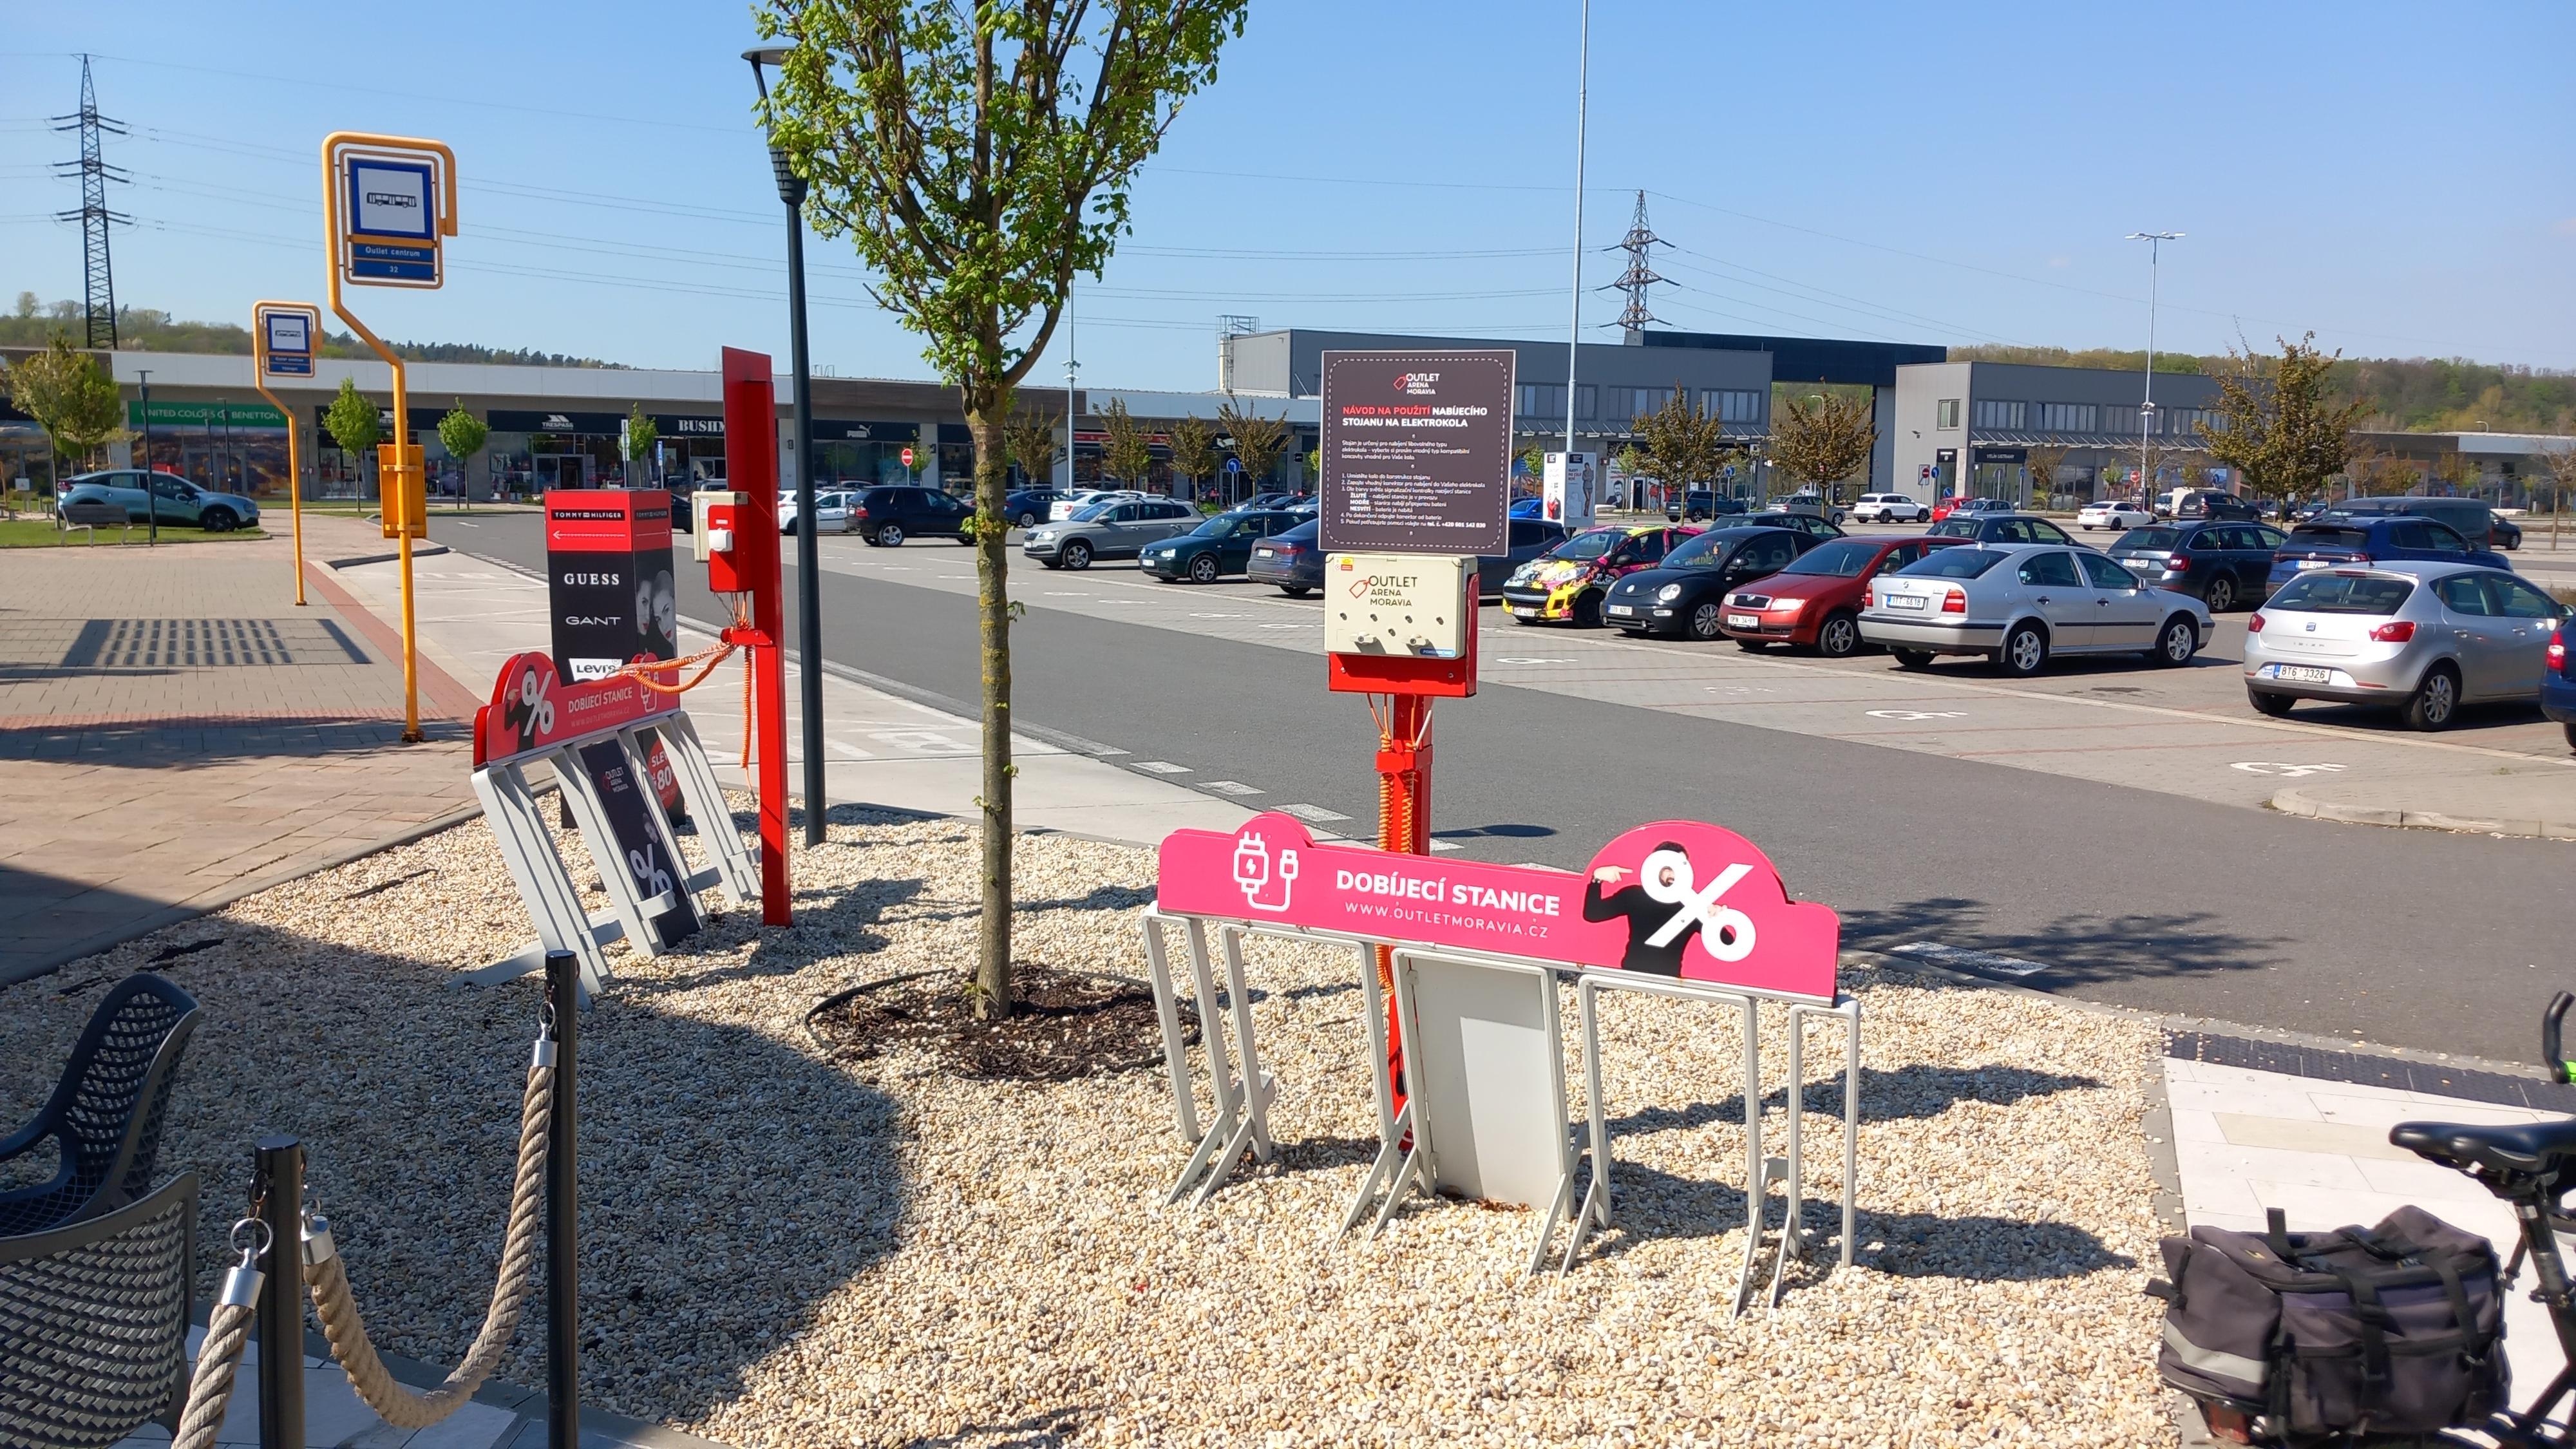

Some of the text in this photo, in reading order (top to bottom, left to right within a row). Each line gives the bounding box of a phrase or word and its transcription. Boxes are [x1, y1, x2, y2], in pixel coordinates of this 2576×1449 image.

[365, 246, 388, 254] Outlet
[1343, 405, 1375, 414] NÁVOD
[1394, 405, 1430, 415] POUŽITÍ
[1432, 405, 1488, 415] NABÍJECÍHO
[1342, 418, 1383, 426] STOJANU
[1401, 419, 1468, 427] ELEKTROKOLA
[564, 573, 620, 585] GUESS
[1368, 575, 1417, 587] OUTLET
[1370, 598, 1412, 607] MORAVIA
[565, 616, 621, 626] GANT
[2282, 667, 2325, 679] 8T6 3326
[569, 687, 632, 714] DOBÍJECÍ STANICE
[605, 766, 623, 780] OUTLET
[1336, 869, 1560, 916] DOBÍJECÍ STANICE
[1345, 902, 1549, 938] WWW.OUTLETMORAVIA.CZ
